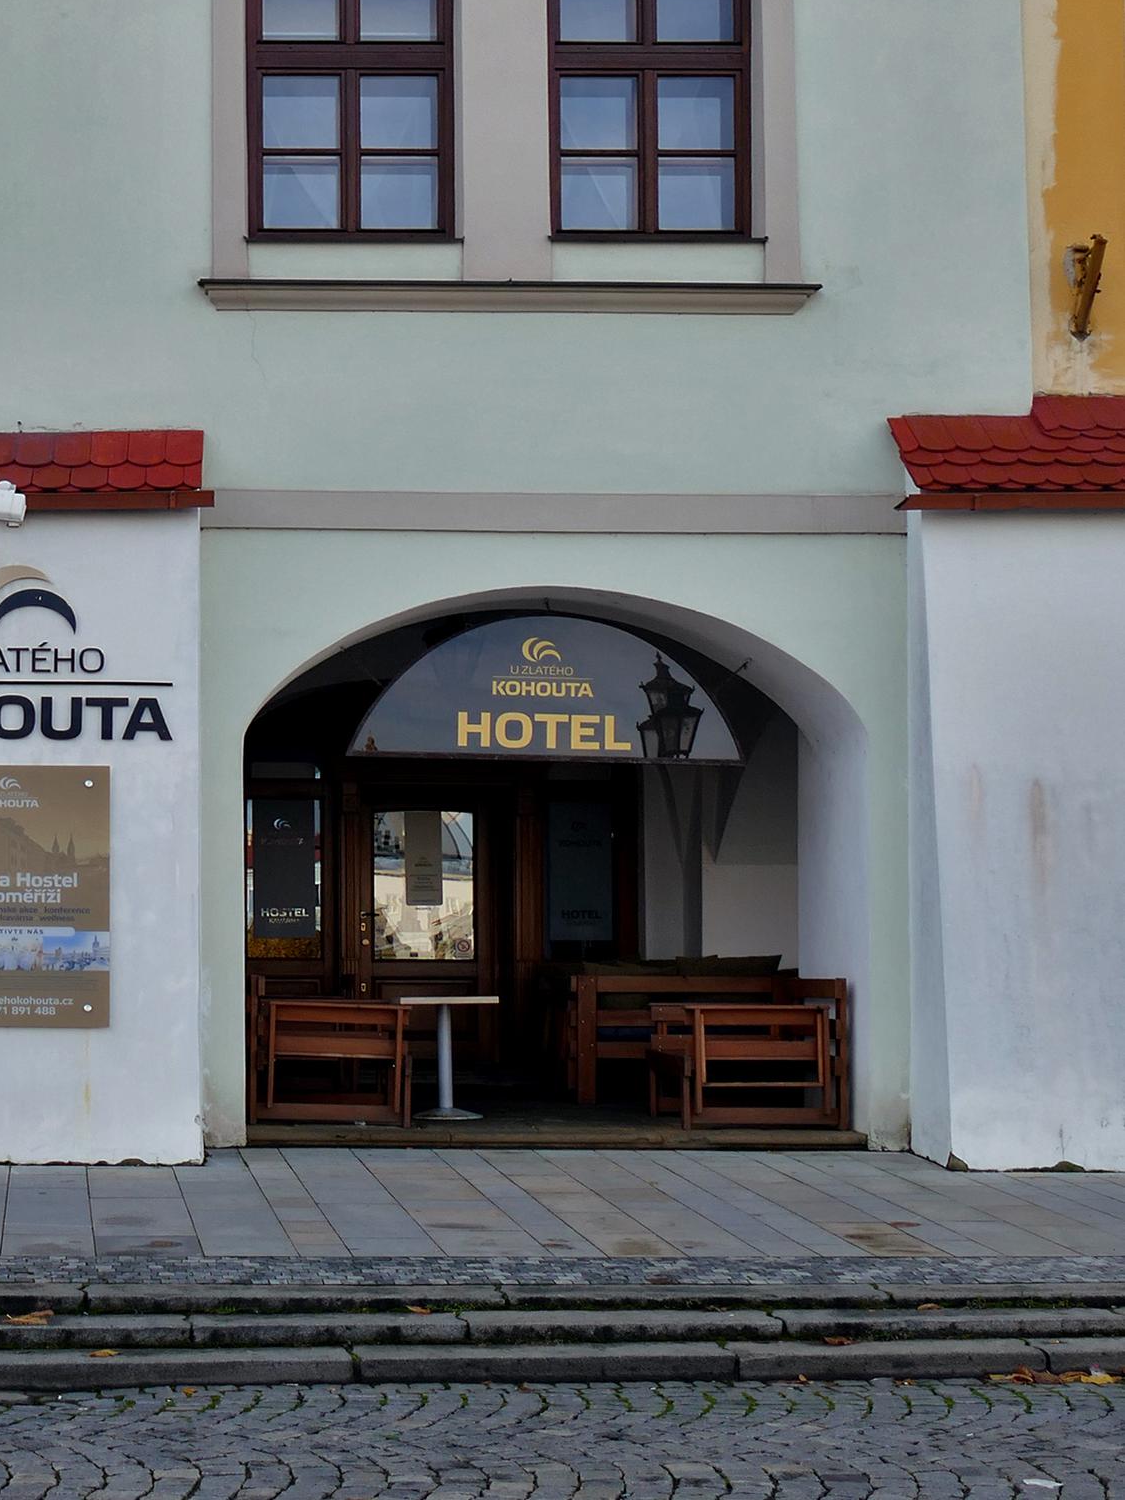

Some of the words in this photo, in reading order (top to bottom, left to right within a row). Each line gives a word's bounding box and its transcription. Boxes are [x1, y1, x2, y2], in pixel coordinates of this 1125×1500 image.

[510, 665, 519, 675] U
[492, 680, 594, 698] KOHOUTA
[457, 711, 632, 751] HOTEL
[0, 875, 11, 888] a
[16, 872, 78, 888] Hostel
[261, 908, 309, 918] HOSTEL
[561, 909, 603, 920] HOTEL
[11, 1006, 31, 1015] 891
[34, 1007, 56, 1016] 488
